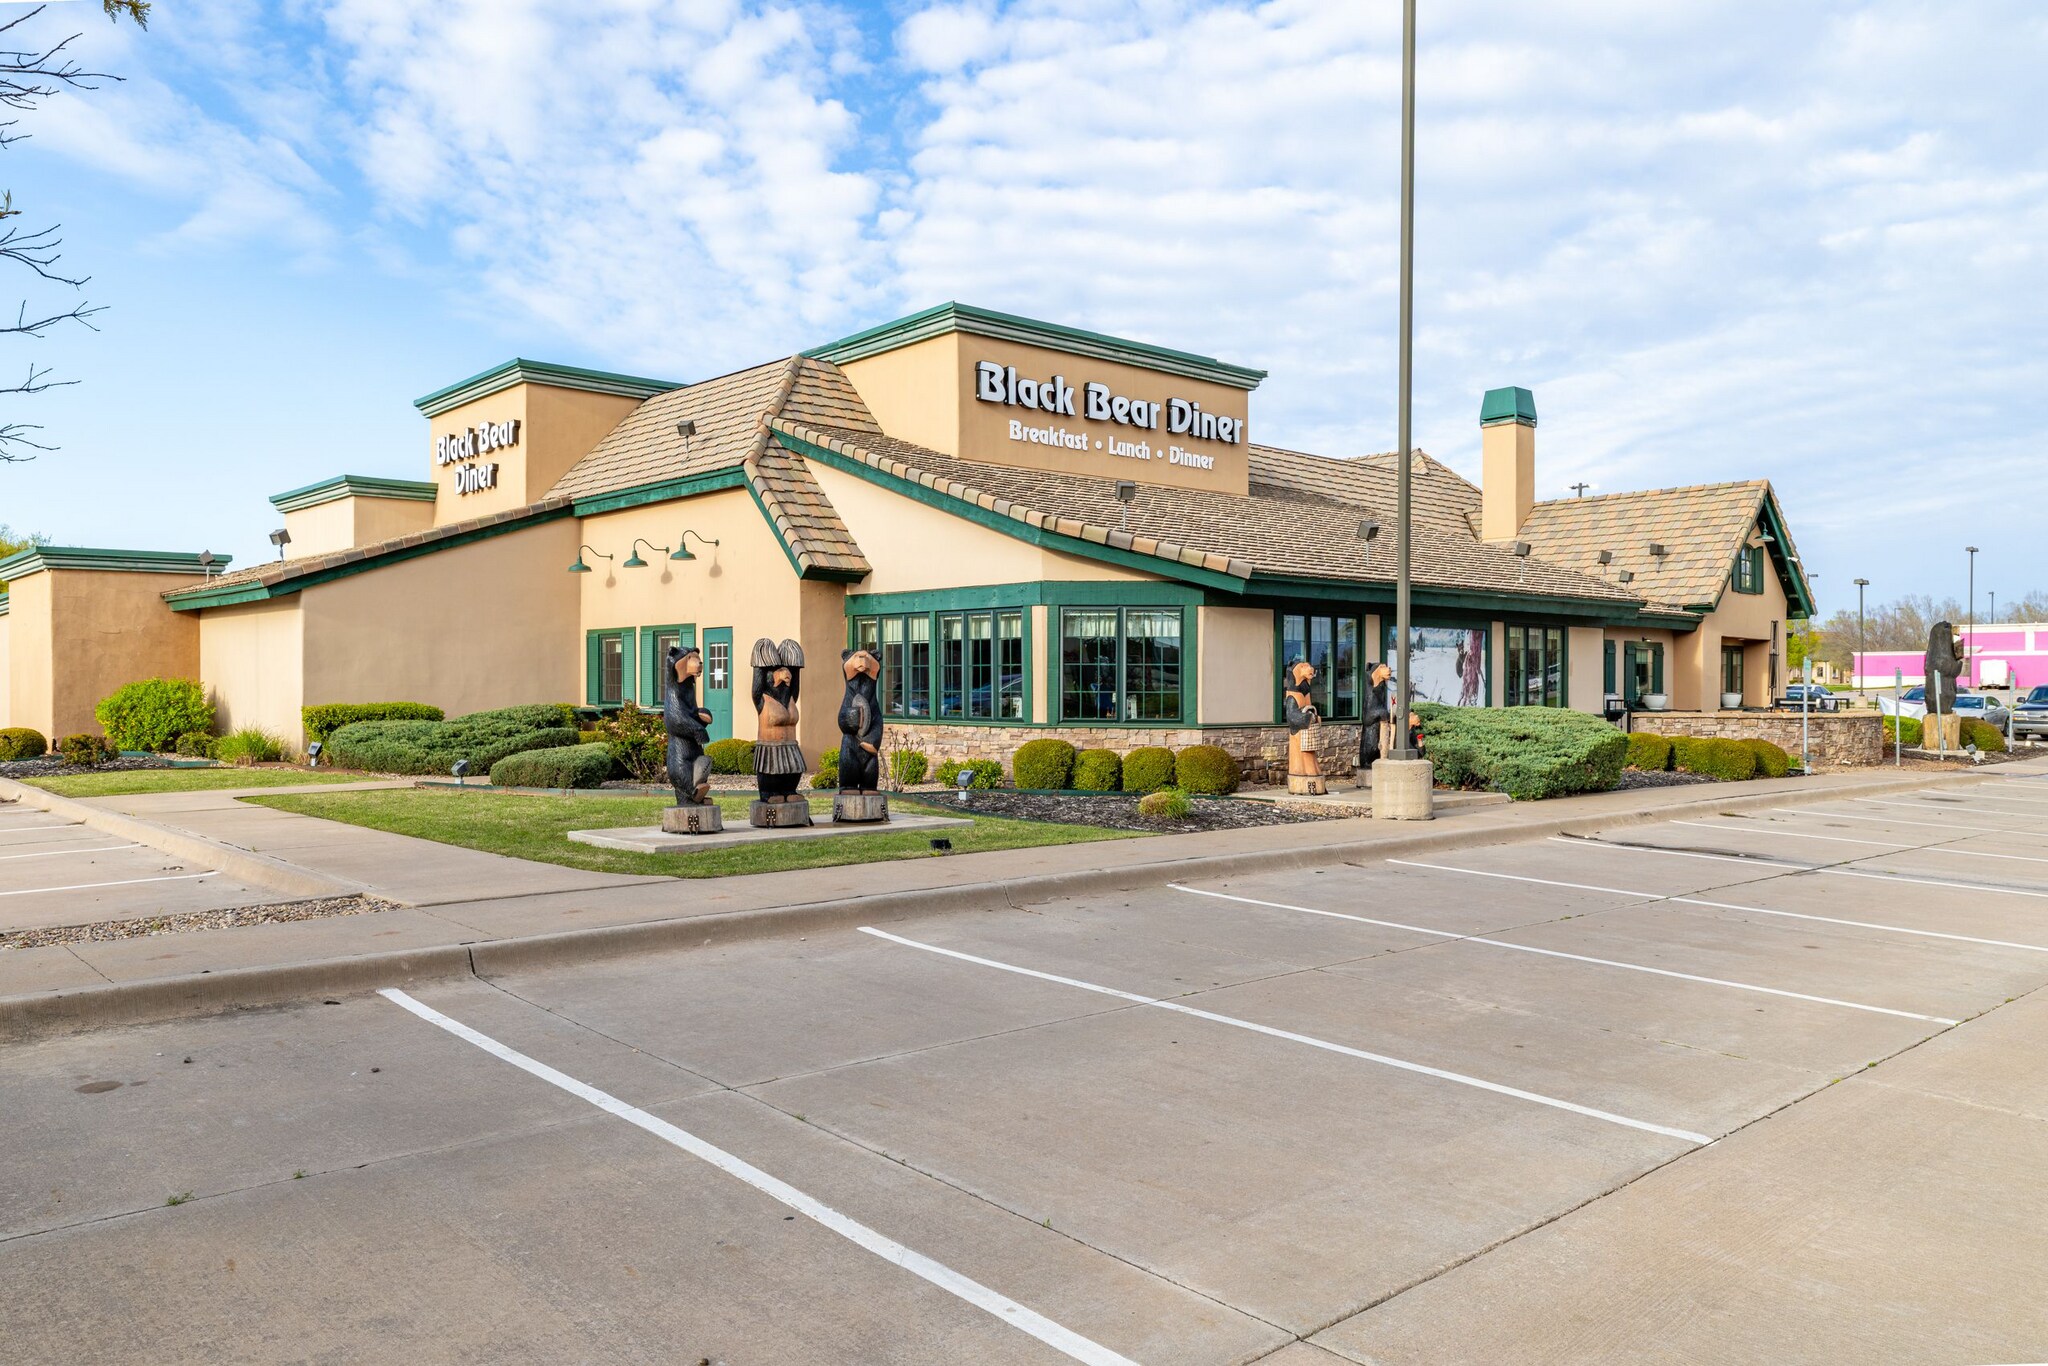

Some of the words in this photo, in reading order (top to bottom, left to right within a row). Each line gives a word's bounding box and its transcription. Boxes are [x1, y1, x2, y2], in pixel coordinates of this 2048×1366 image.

[975, 360, 1076, 416] Black
[1084, 381, 1160, 429] Bear
[1166, 398, 1244, 444] Diner
[437, 427, 478, 466] Black
[479, 419, 520, 453] Bear
[1009, 420, 1088, 450] Breakfast
[1108, 436, 1150, 460] Lunch
[1169, 446, 1215, 470] Dinner
[455, 463, 498, 495] Diner
